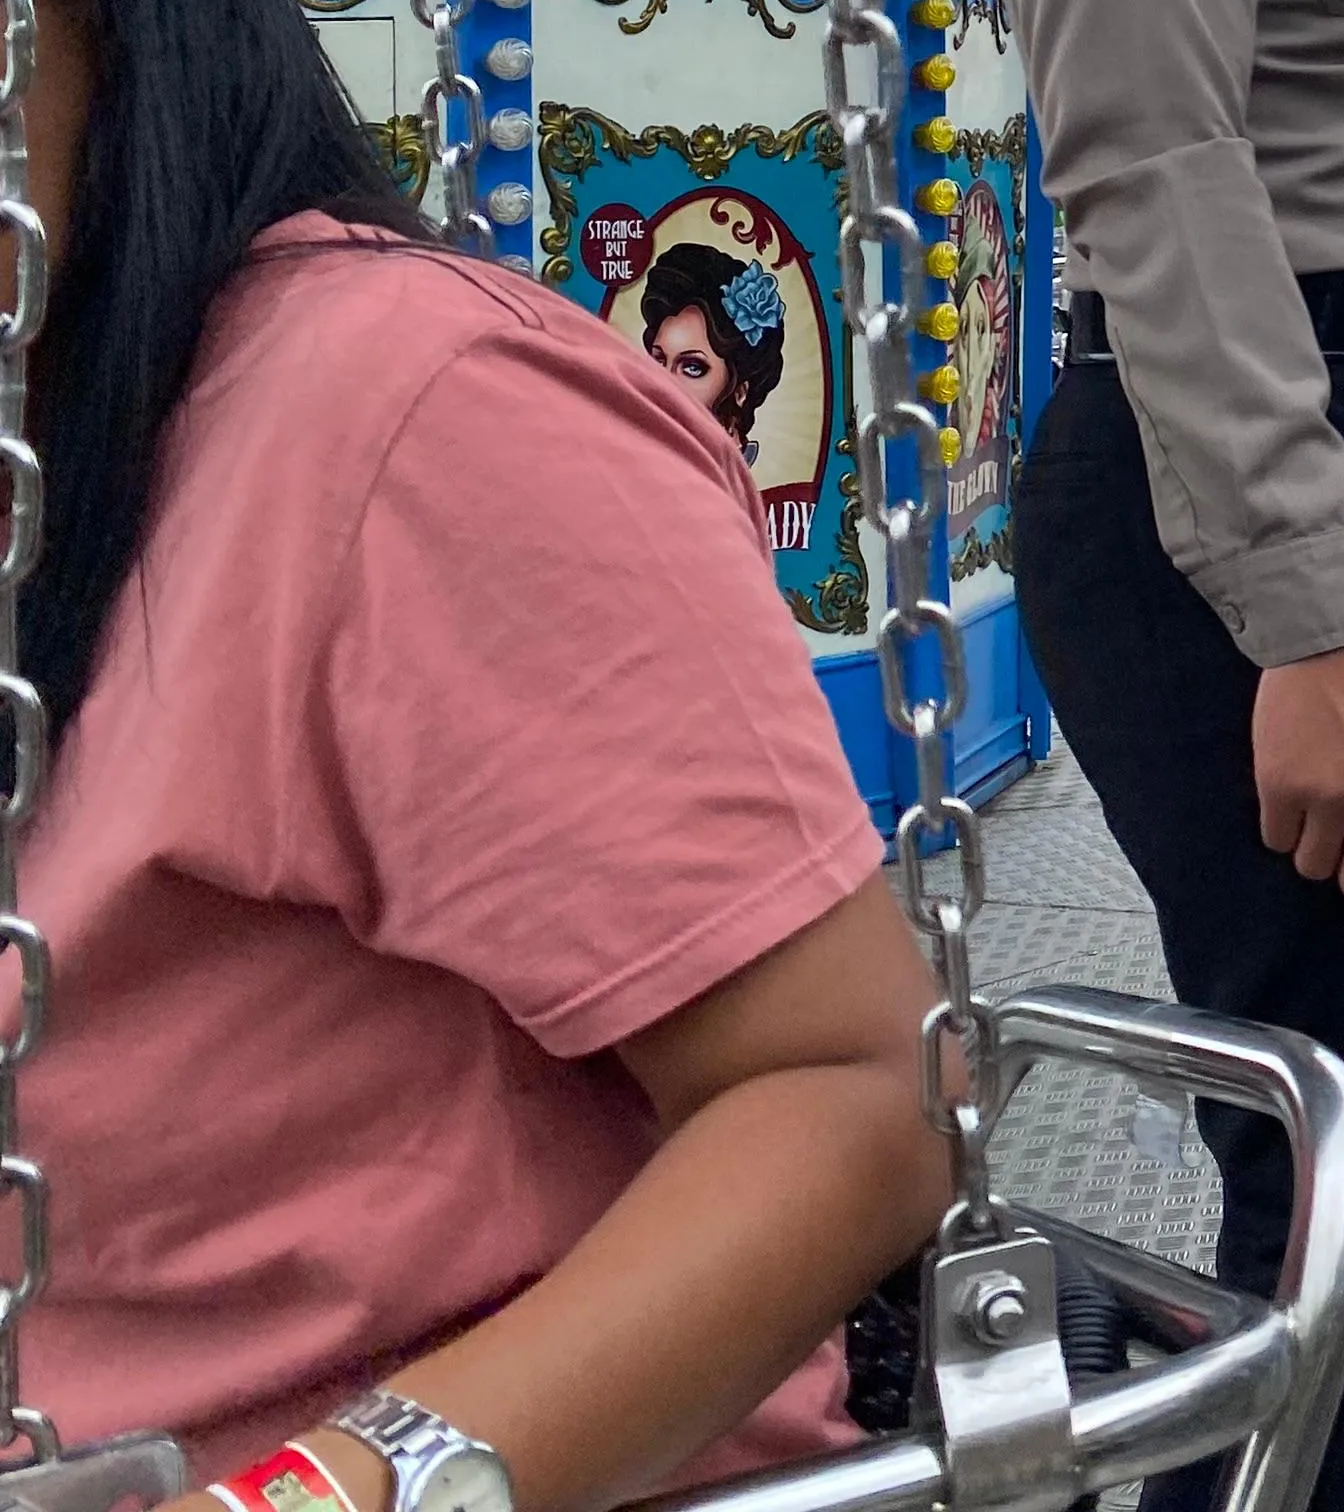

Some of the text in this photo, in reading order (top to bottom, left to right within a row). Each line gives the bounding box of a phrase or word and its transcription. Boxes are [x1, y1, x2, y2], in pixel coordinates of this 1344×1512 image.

[588, 220, 645, 239] STRANGE
[605, 241, 627, 257] BUT
[600, 260, 634, 280] TRUE
[767, 500, 817, 550] ADY
